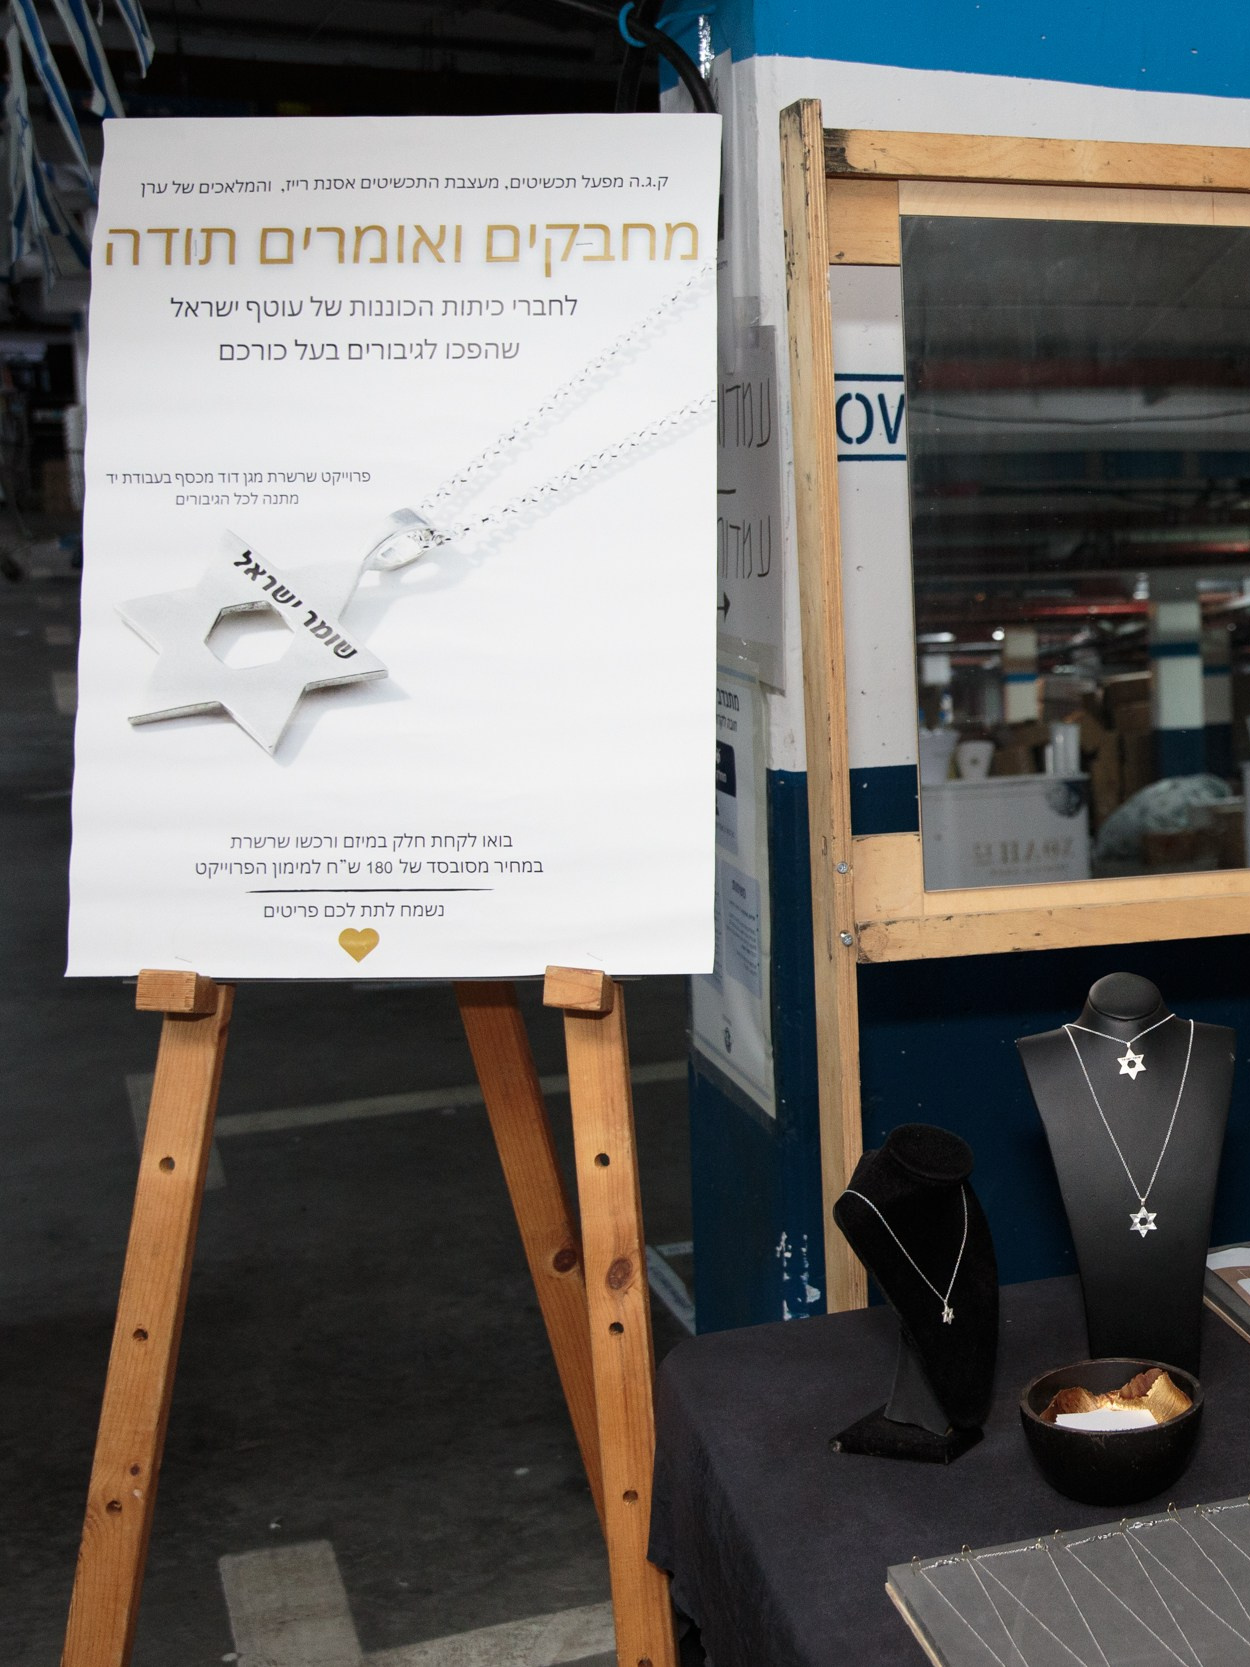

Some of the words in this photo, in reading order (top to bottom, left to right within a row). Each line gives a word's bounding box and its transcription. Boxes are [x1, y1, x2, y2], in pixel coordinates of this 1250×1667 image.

[172, 181, 194, 194] של
[199, 179, 271, 194] והמלאכים
[315, 179, 355, 190] אסנת
[361, 178, 439, 189] התכשיטים
[446, 178, 498, 188] מעצבת
[582, 175, 623, 188] מפעל
[141, 183, 167, 197] ערן
[106, 228, 235, 265] תודה
[259, 225, 461, 265] ואומרים
[486, 222, 698, 277] מחבקים
[171, 297, 238, 317] ישראל
[246, 300, 303, 323] עוטף
[310, 296, 342, 316] של
[350, 300, 433, 316] הכוננות
[442, 300, 503, 316] כיתות
[513, 295, 577, 315] לחברי
[220, 344, 287, 360] כורכם
[295, 339, 339, 360] בעל
[348, 339, 437, 360] לגיבורים
[446, 343, 519, 359] שהפכו
[106, 474, 117, 484] יד
[122, 474, 172, 484] בעבודת
[175, 473, 213, 487] מכסף
[218, 473, 239, 483] דוד
[243, 473, 262, 486] מגן
[268, 472, 317, 482] שרשרת
[322, 472, 370, 486] פרוייקט
[176, 495, 229, 505] הגיבורים
[234, 492, 258, 504] לכל
[263, 494, 298, 504] מתנה
[233, 549, 303, 609] ישראל
[302, 609, 359, 660] שומר
[231, 837, 290, 848] שרשרת
[296, 837, 337, 848] ורכשו
[344, 836, 387, 848] במיזם
[393, 833, 425, 852] חלק
[431, 833, 477, 851] לקחת
[483, 836, 513, 847] בואו
[196, 863, 266, 879] הפרוייקט
[272, 859, 321, 878] למימון
[367, 861, 392, 874] 180
[399, 859, 421, 873] של
[427, 861, 488, 873] מסובסד
[494, 861, 543, 873] במחיר
[264, 906, 318, 918] פריטים
[325, 902, 355, 917] לכם
[361, 902, 395, 917] לתת
[401, 905, 444, 917] נשמח
